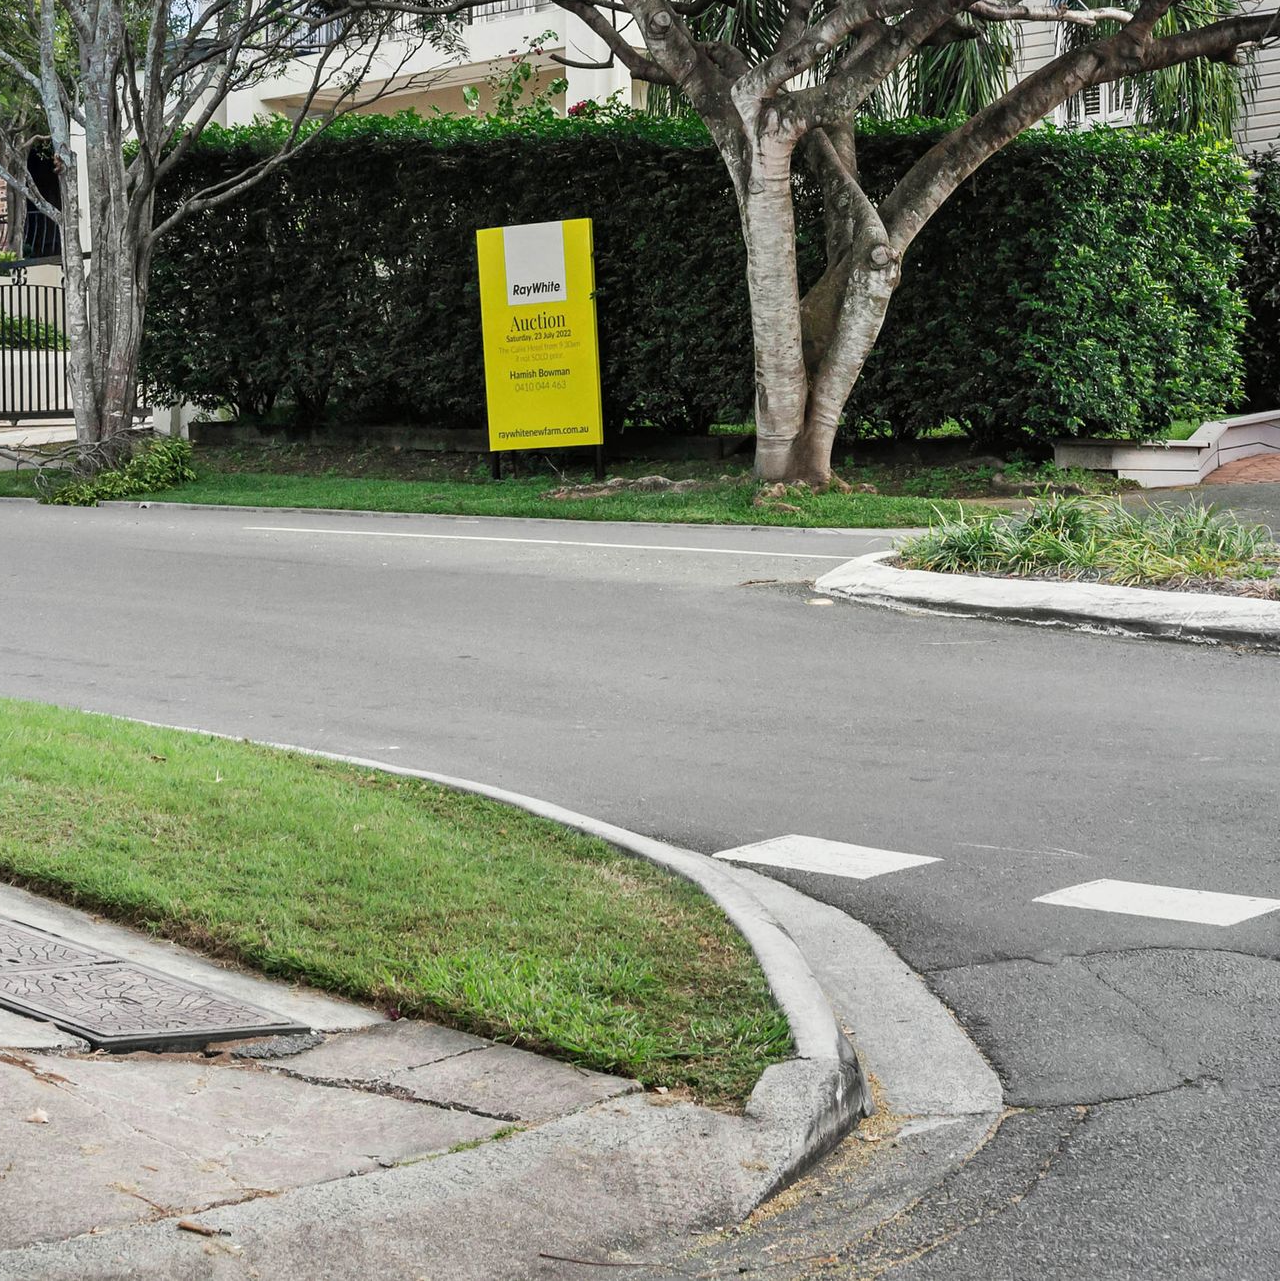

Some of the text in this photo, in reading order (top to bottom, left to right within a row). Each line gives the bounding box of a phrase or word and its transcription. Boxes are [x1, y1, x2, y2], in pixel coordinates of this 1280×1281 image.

[511, 311, 566, 333] Auction
[534, 332, 543, 340] 23
[543, 331, 555, 340] July
[556, 329, 572, 338] 2022
[510, 368, 571, 380] Hamish Bowman
[498, 425, 589, 440] raywhitenewfarm.com.au
